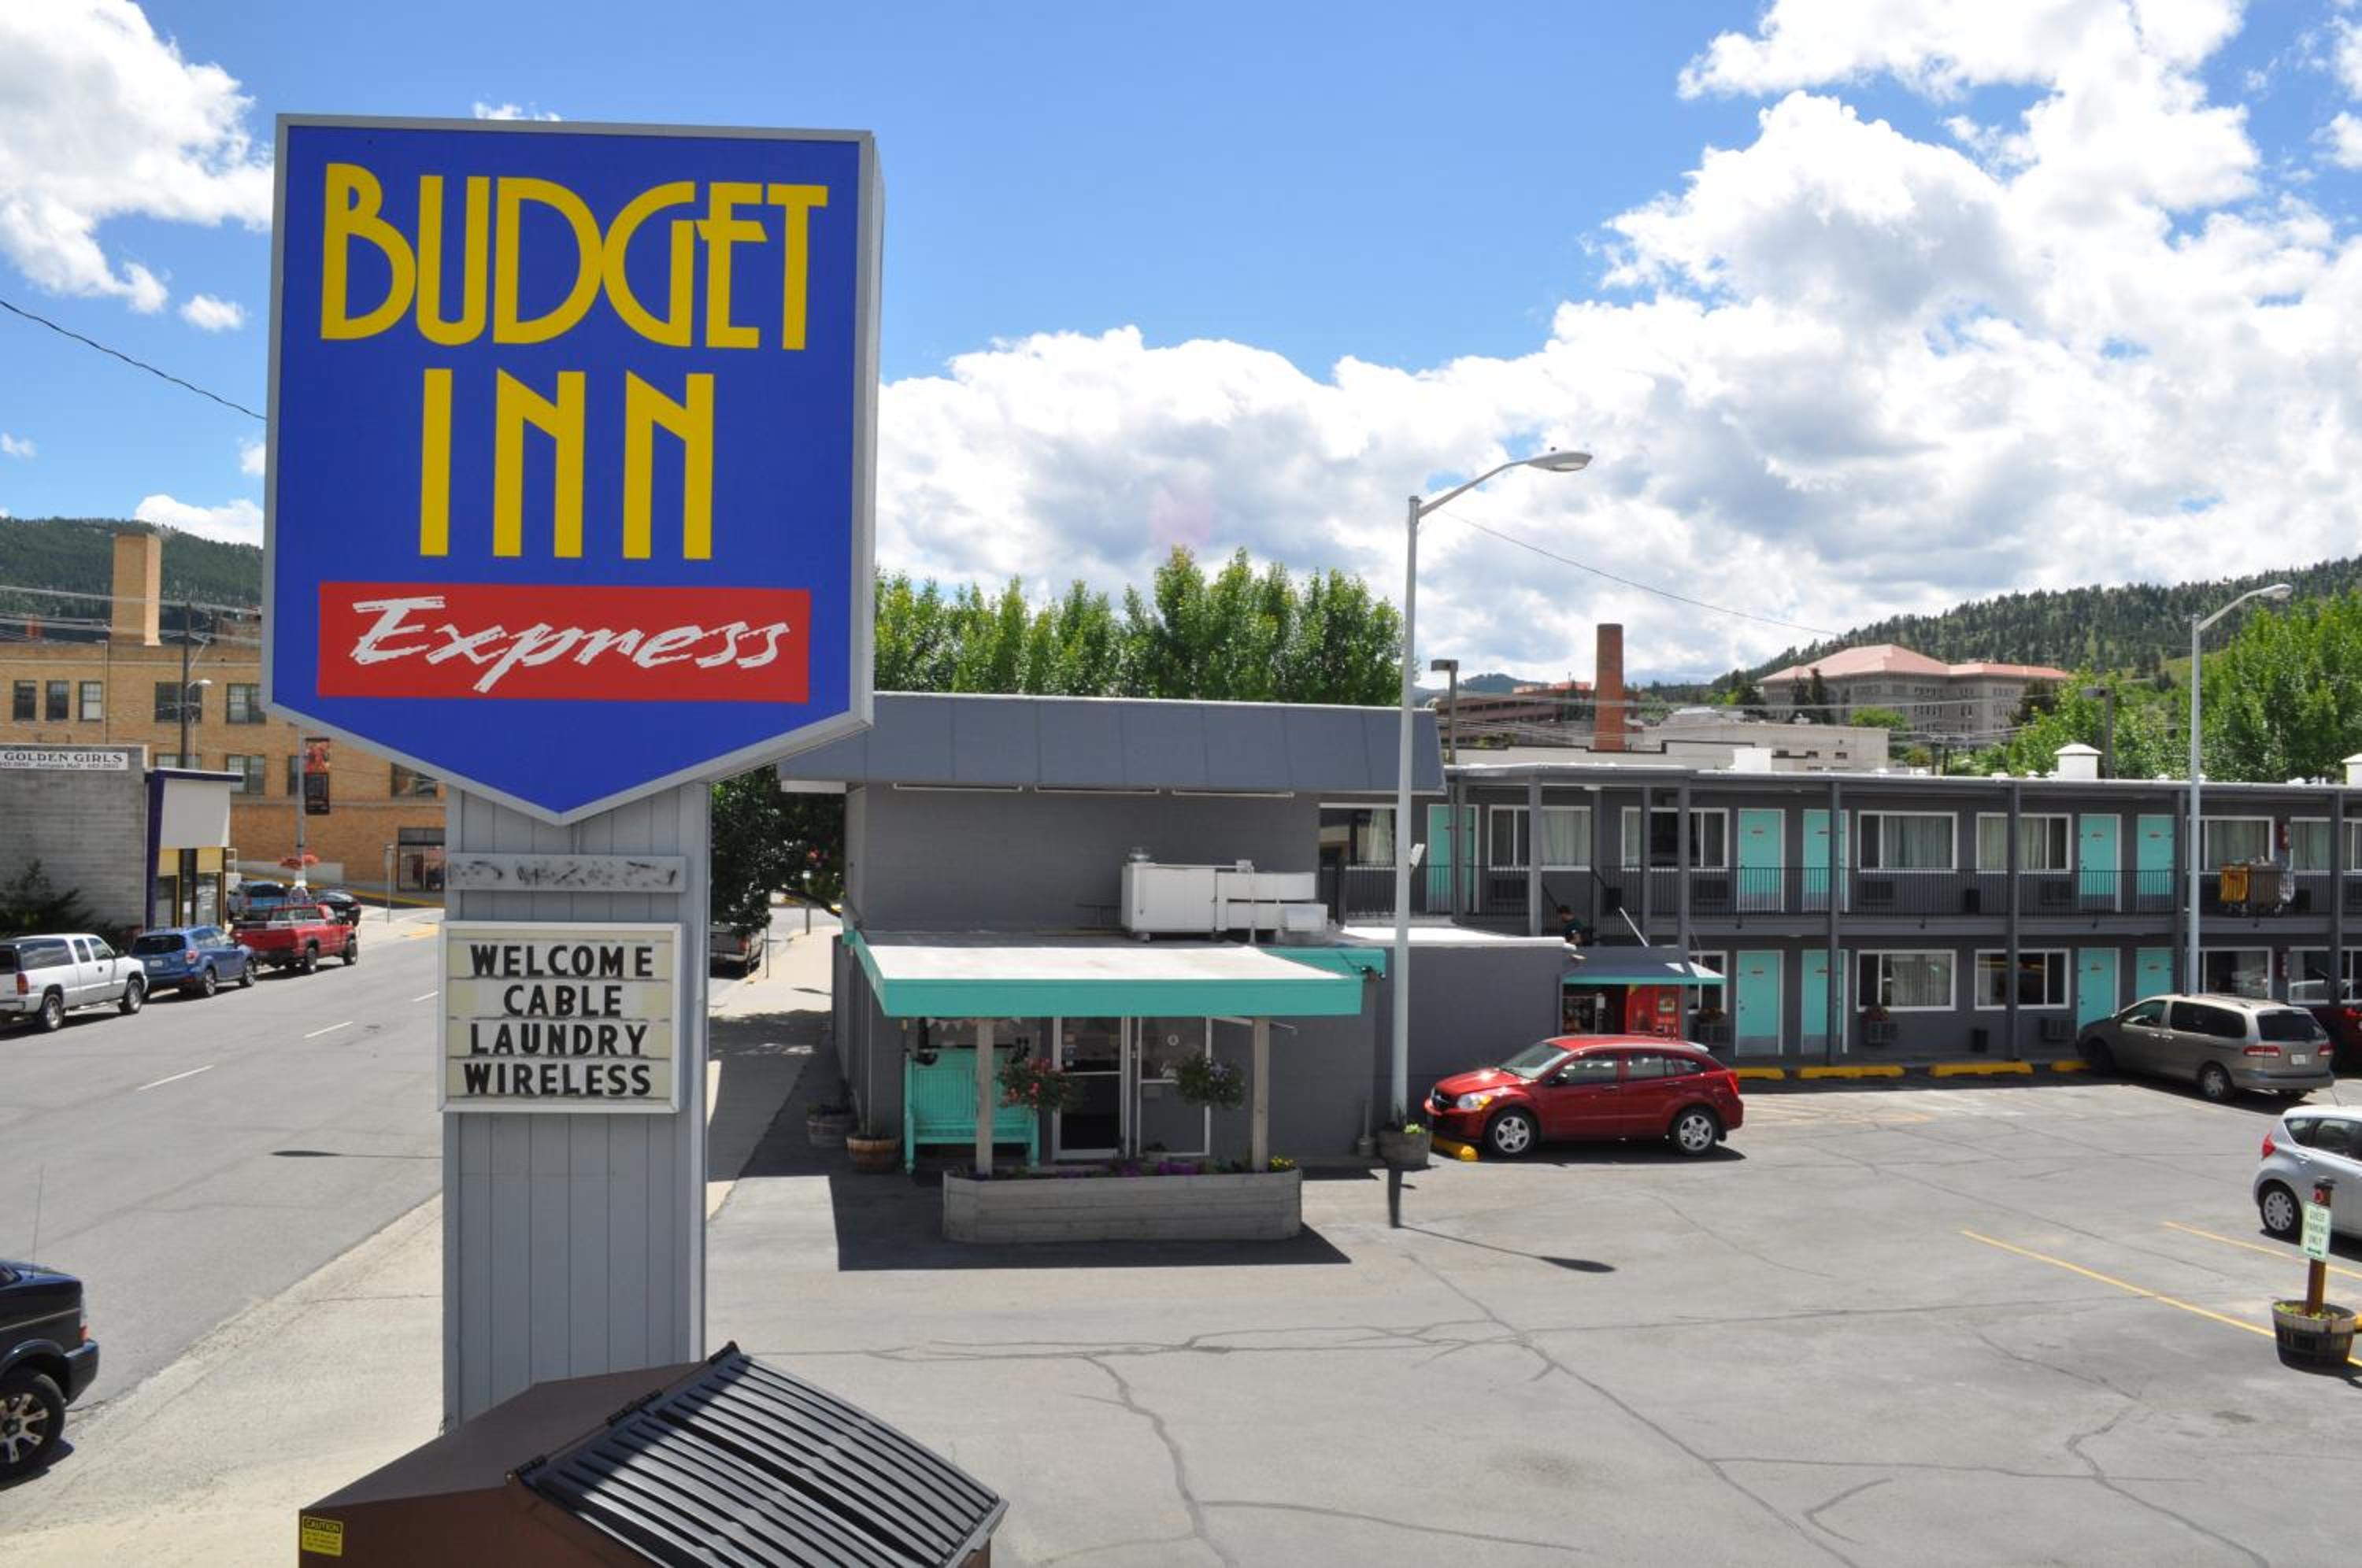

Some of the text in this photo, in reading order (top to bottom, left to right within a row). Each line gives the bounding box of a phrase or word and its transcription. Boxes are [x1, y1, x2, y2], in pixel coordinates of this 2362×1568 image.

[320, 162, 829, 350] BUDGET
[420, 368, 714, 560] INN
[350, 595, 790, 693] Express
[4, 753, 123, 764] GOLDEN GIRLS
[470, 944, 653, 978] WELCOME
[502, 985, 622, 1017] CABLE
[470, 1023, 647, 1056] LAUNDRY
[463, 1063, 651, 1096] WIRELESS
